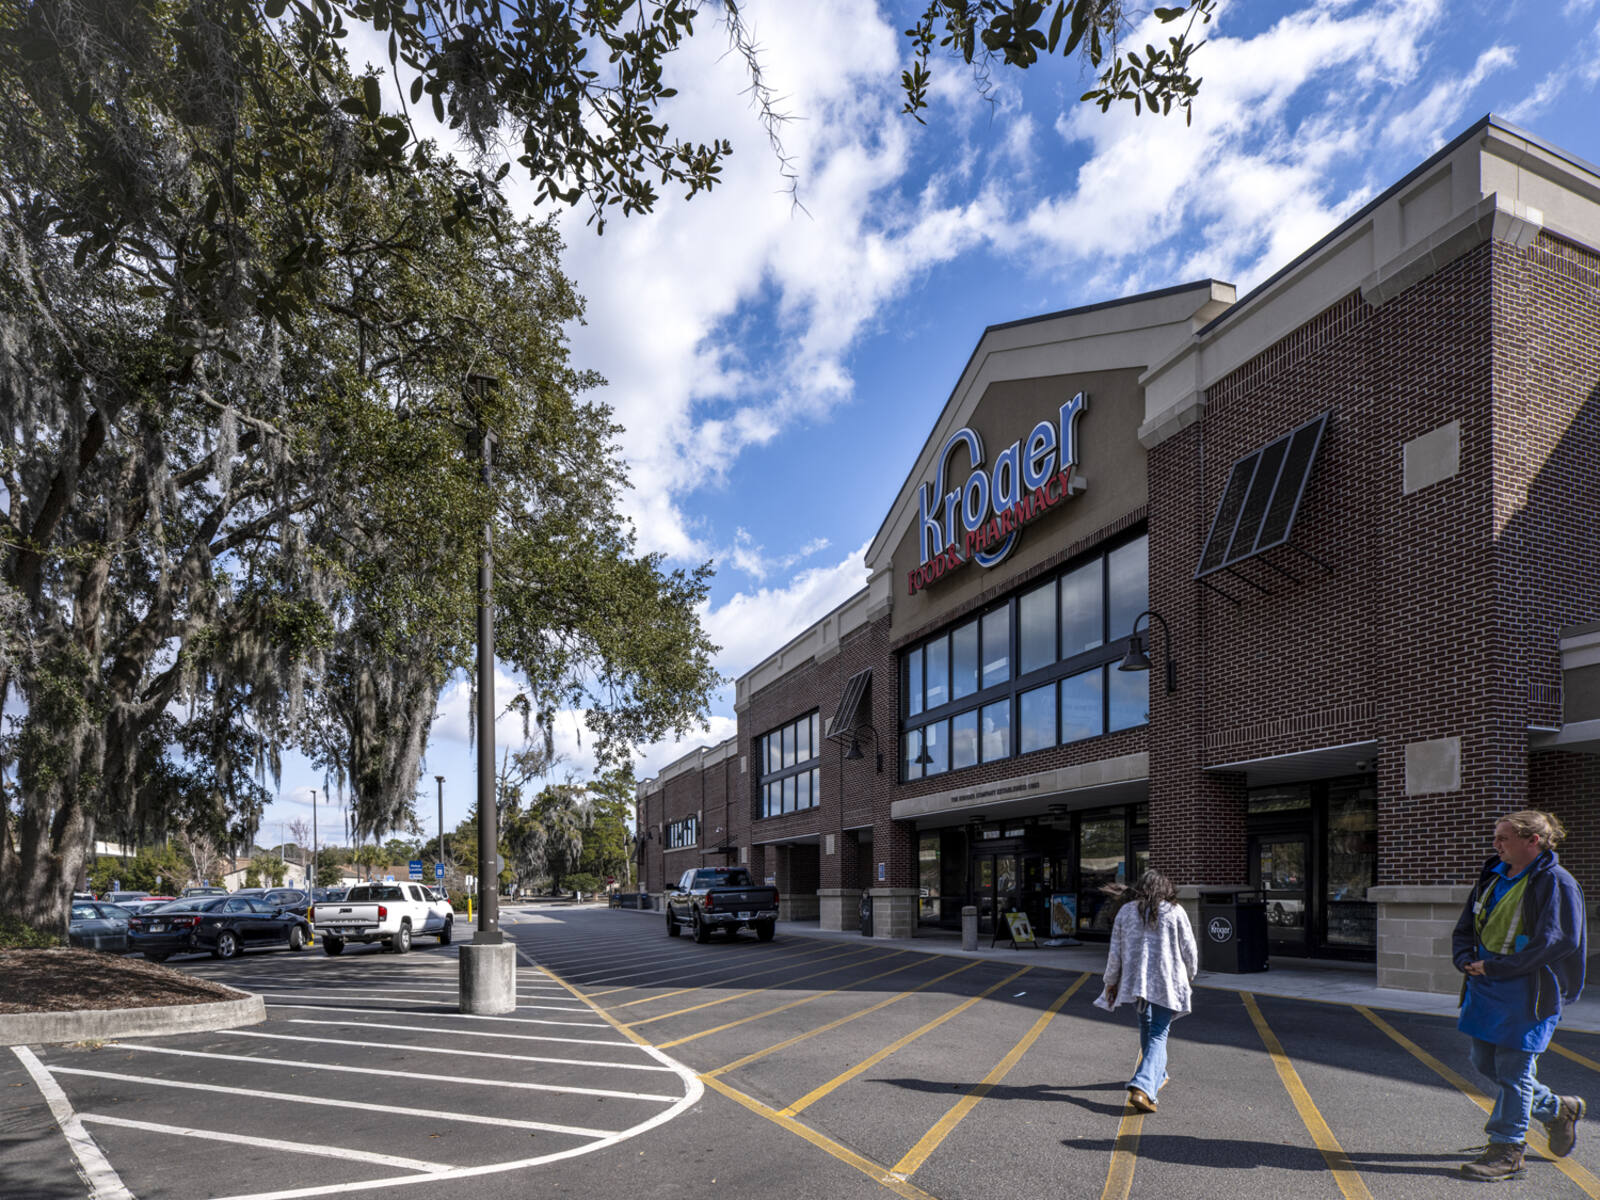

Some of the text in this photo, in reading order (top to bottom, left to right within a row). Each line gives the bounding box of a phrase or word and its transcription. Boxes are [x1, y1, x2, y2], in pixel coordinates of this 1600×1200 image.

[908, 467, 1071, 595] FOOD & PHARMACY
[919, 391, 1085, 567] Kroger
[1211, 921, 1230, 939] Kroger
